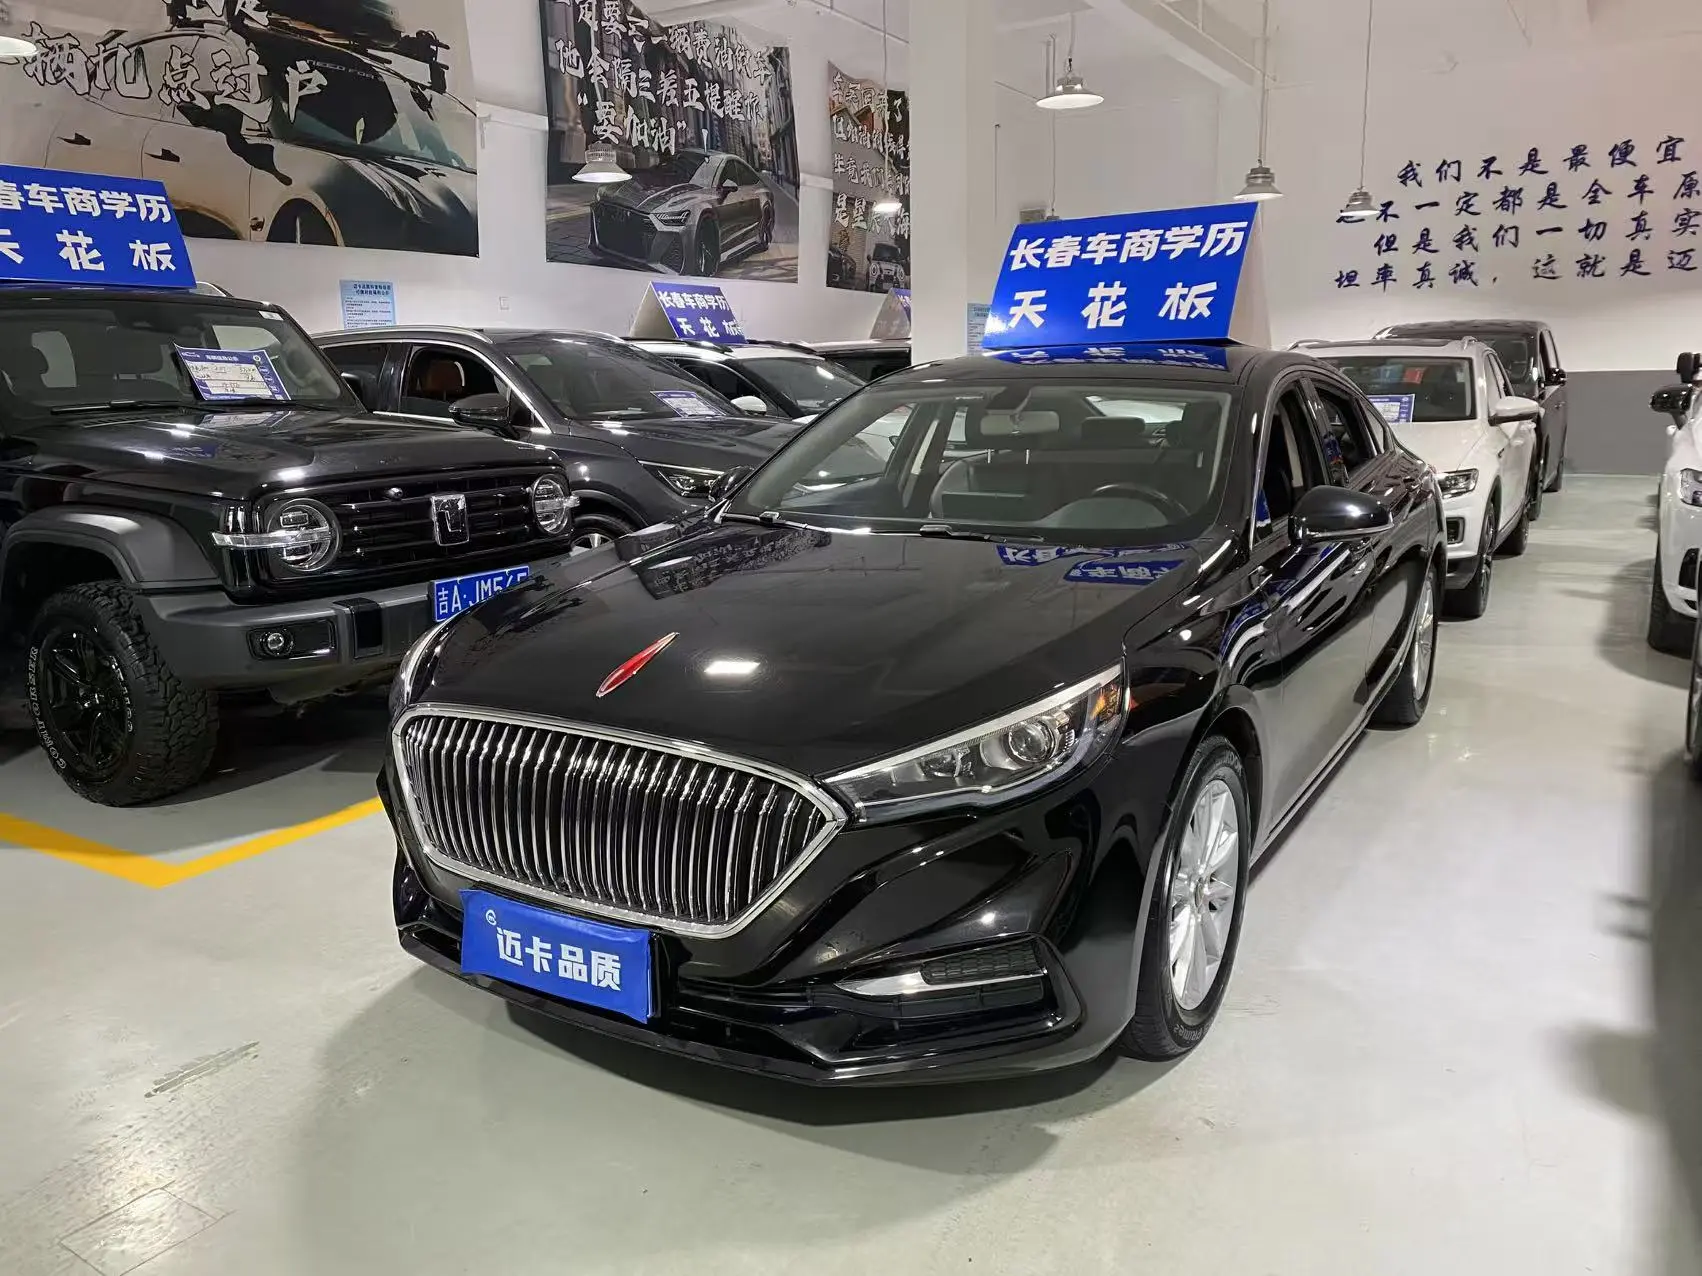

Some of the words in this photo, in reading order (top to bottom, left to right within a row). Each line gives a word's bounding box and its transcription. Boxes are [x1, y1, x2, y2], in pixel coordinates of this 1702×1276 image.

[1397, 135, 1685, 187] 我们不是最便宜
[1010, 221, 1249, 271] 长春车商学历
[1373, 208, 1702, 256] 但是我们一切真实
[657, 290, 730, 311] 长春车商学历
[1008, 281, 1218, 329] 天花板
[676, 316, 743, 337] 天花板
[496, 926, 621, 991] 迈卡品质
